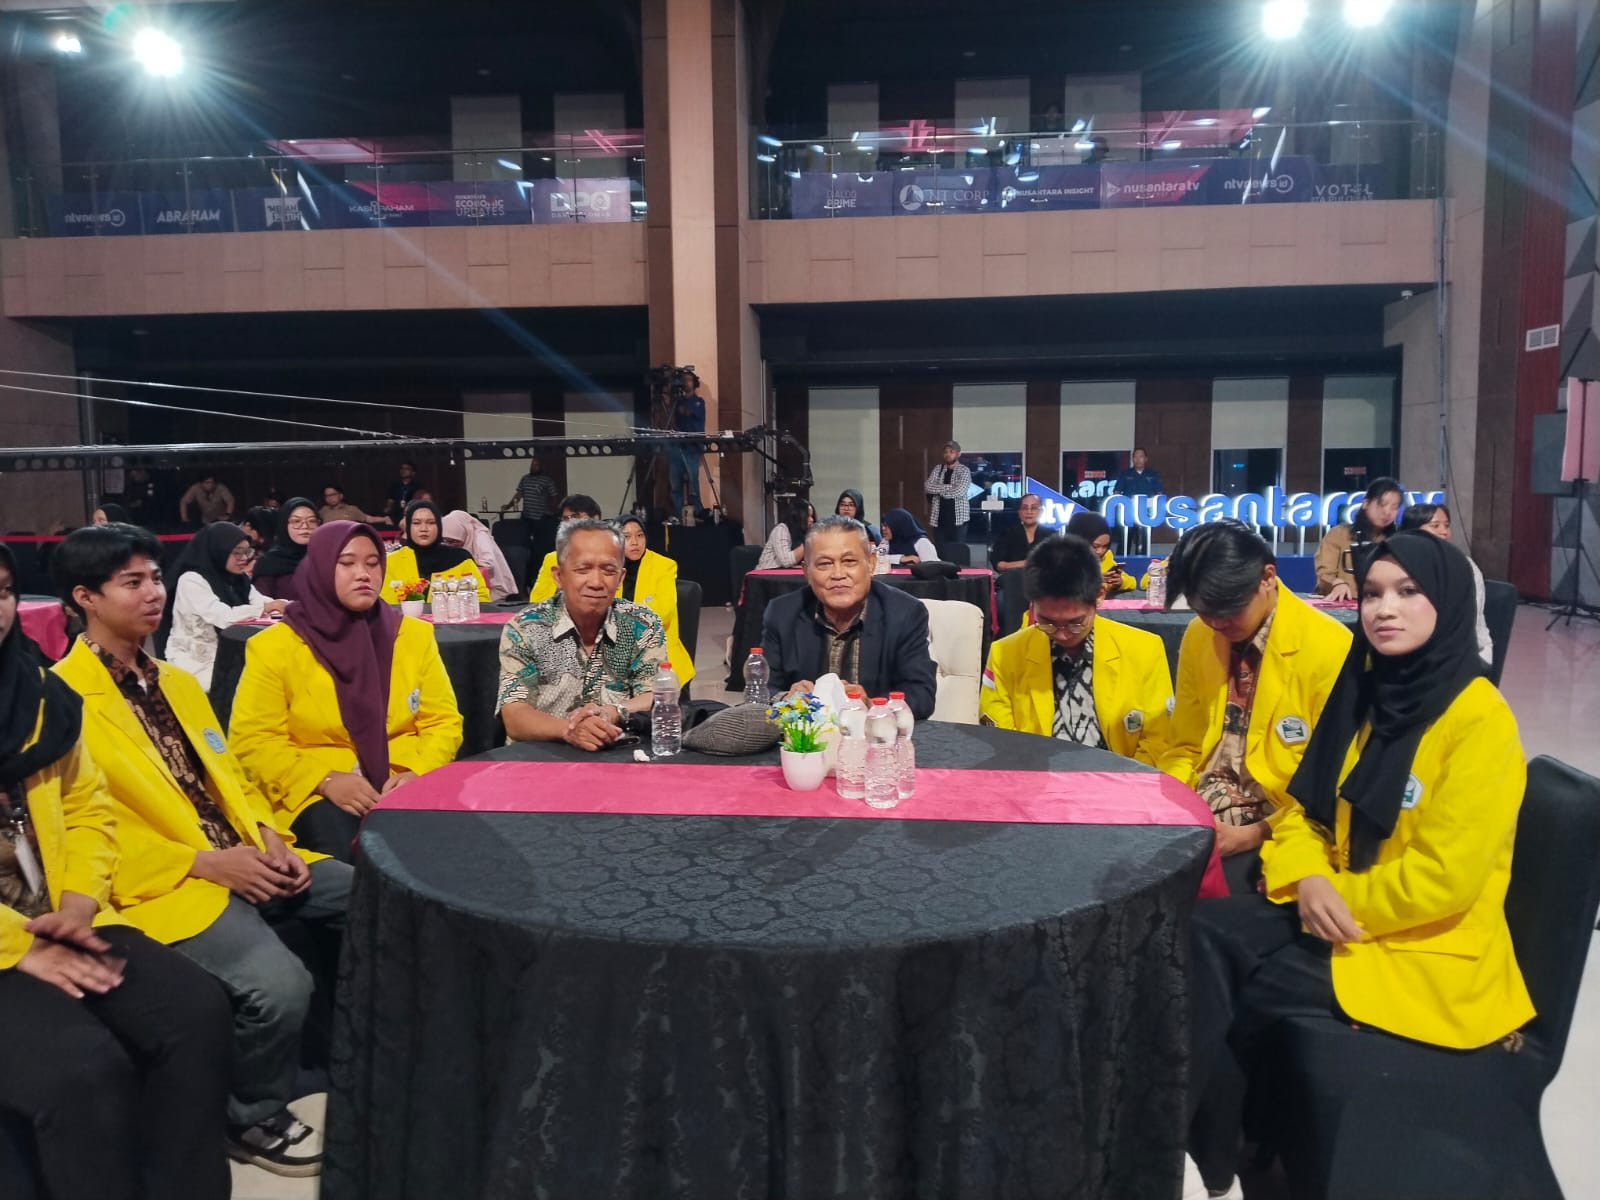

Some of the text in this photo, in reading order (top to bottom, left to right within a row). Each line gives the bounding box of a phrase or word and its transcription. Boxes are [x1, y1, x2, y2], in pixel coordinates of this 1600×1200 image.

[826, 199, 857, 208] PRIME
[156, 209, 221, 224] ABRAHAM
[455, 207, 505, 217] UPDATES
